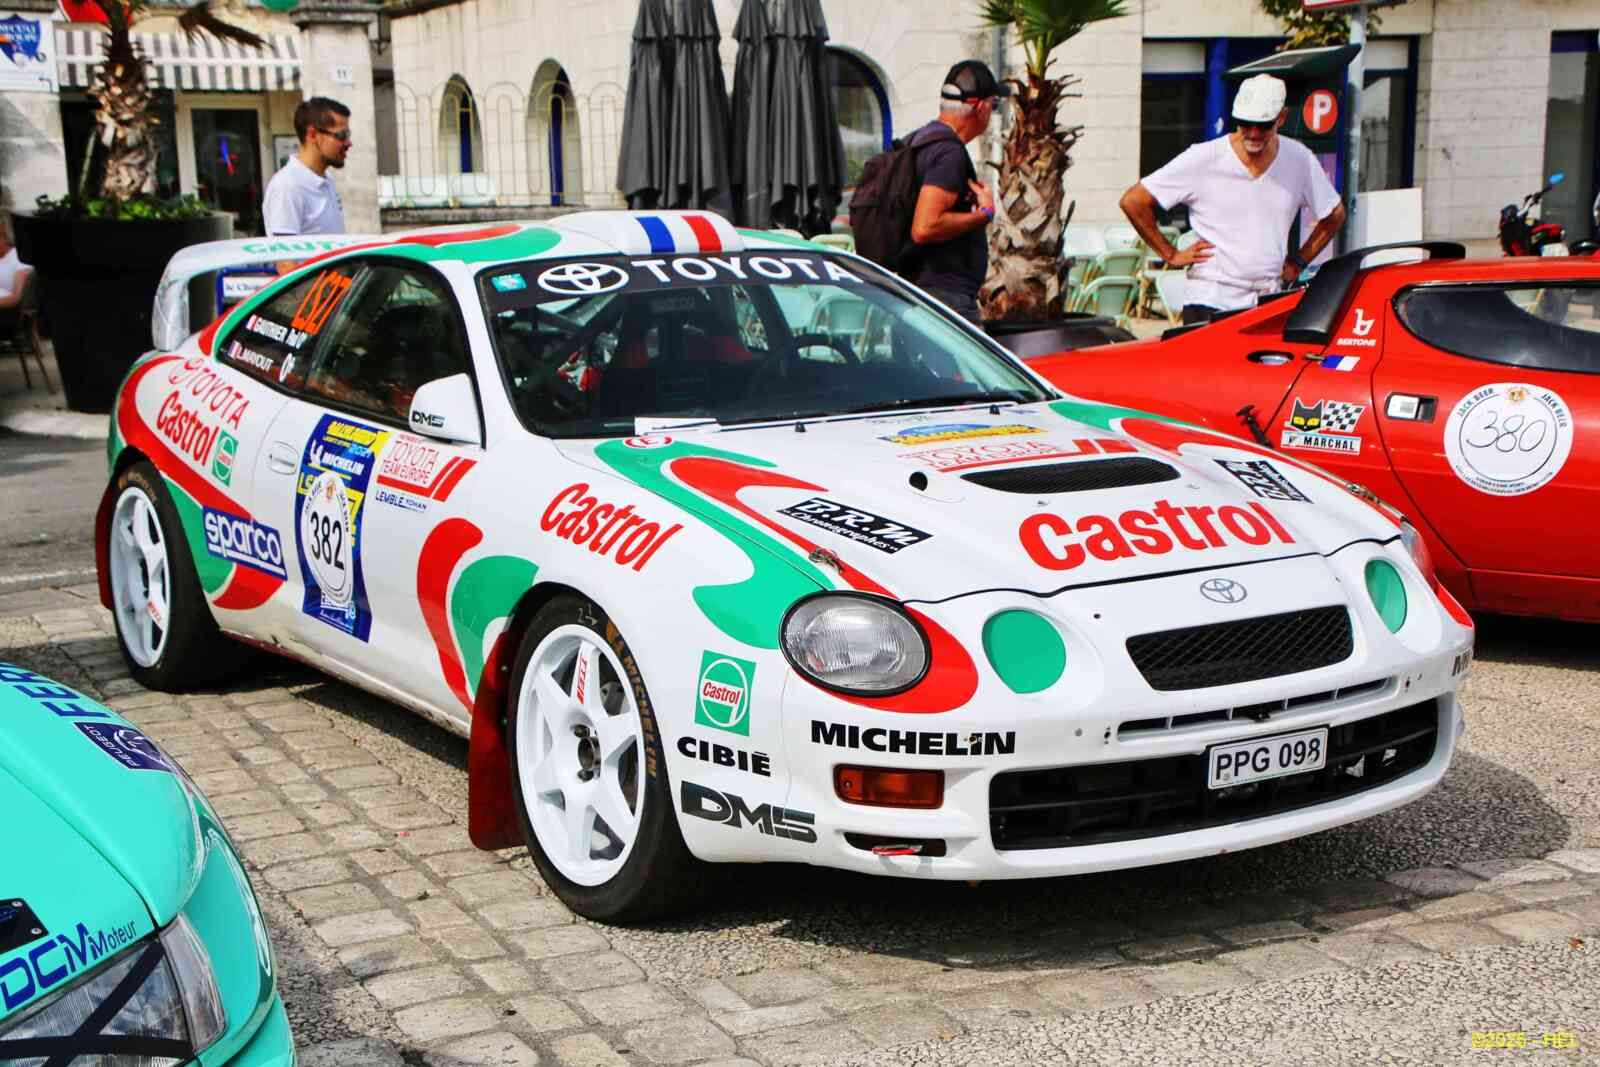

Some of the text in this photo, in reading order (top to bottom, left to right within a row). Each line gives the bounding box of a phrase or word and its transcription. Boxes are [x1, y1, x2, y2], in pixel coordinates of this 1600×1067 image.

[1312, 94, 1331, 130] P
[631, 257, 865, 284] TOYOTA
[1337, 337, 1377, 347] BERTONE
[185, 367, 250, 430] TOYOTA
[156, 390, 220, 466] Castrol
[1303, 436, 1355, 450] MARCHAL
[1466, 410, 1547, 453] 380
[322, 451, 365, 476] MICHELIN
[386, 440, 440, 471] TOYOTA
[204, 511, 281, 566] sparco
[310, 511, 345, 571] 382
[540, 482, 685, 572] Castrol
[1019, 499, 1296, 571] Castrol
[702, 681, 741, 705] Castrol
[83, 724, 141, 767] PEUGEOT
[811, 719, 1016, 756] MICHELIN
[1215, 737, 1321, 781] PPG 098
[681, 780, 818, 844] DMS
[0, 920, 138, 1012] DCM Moteur
